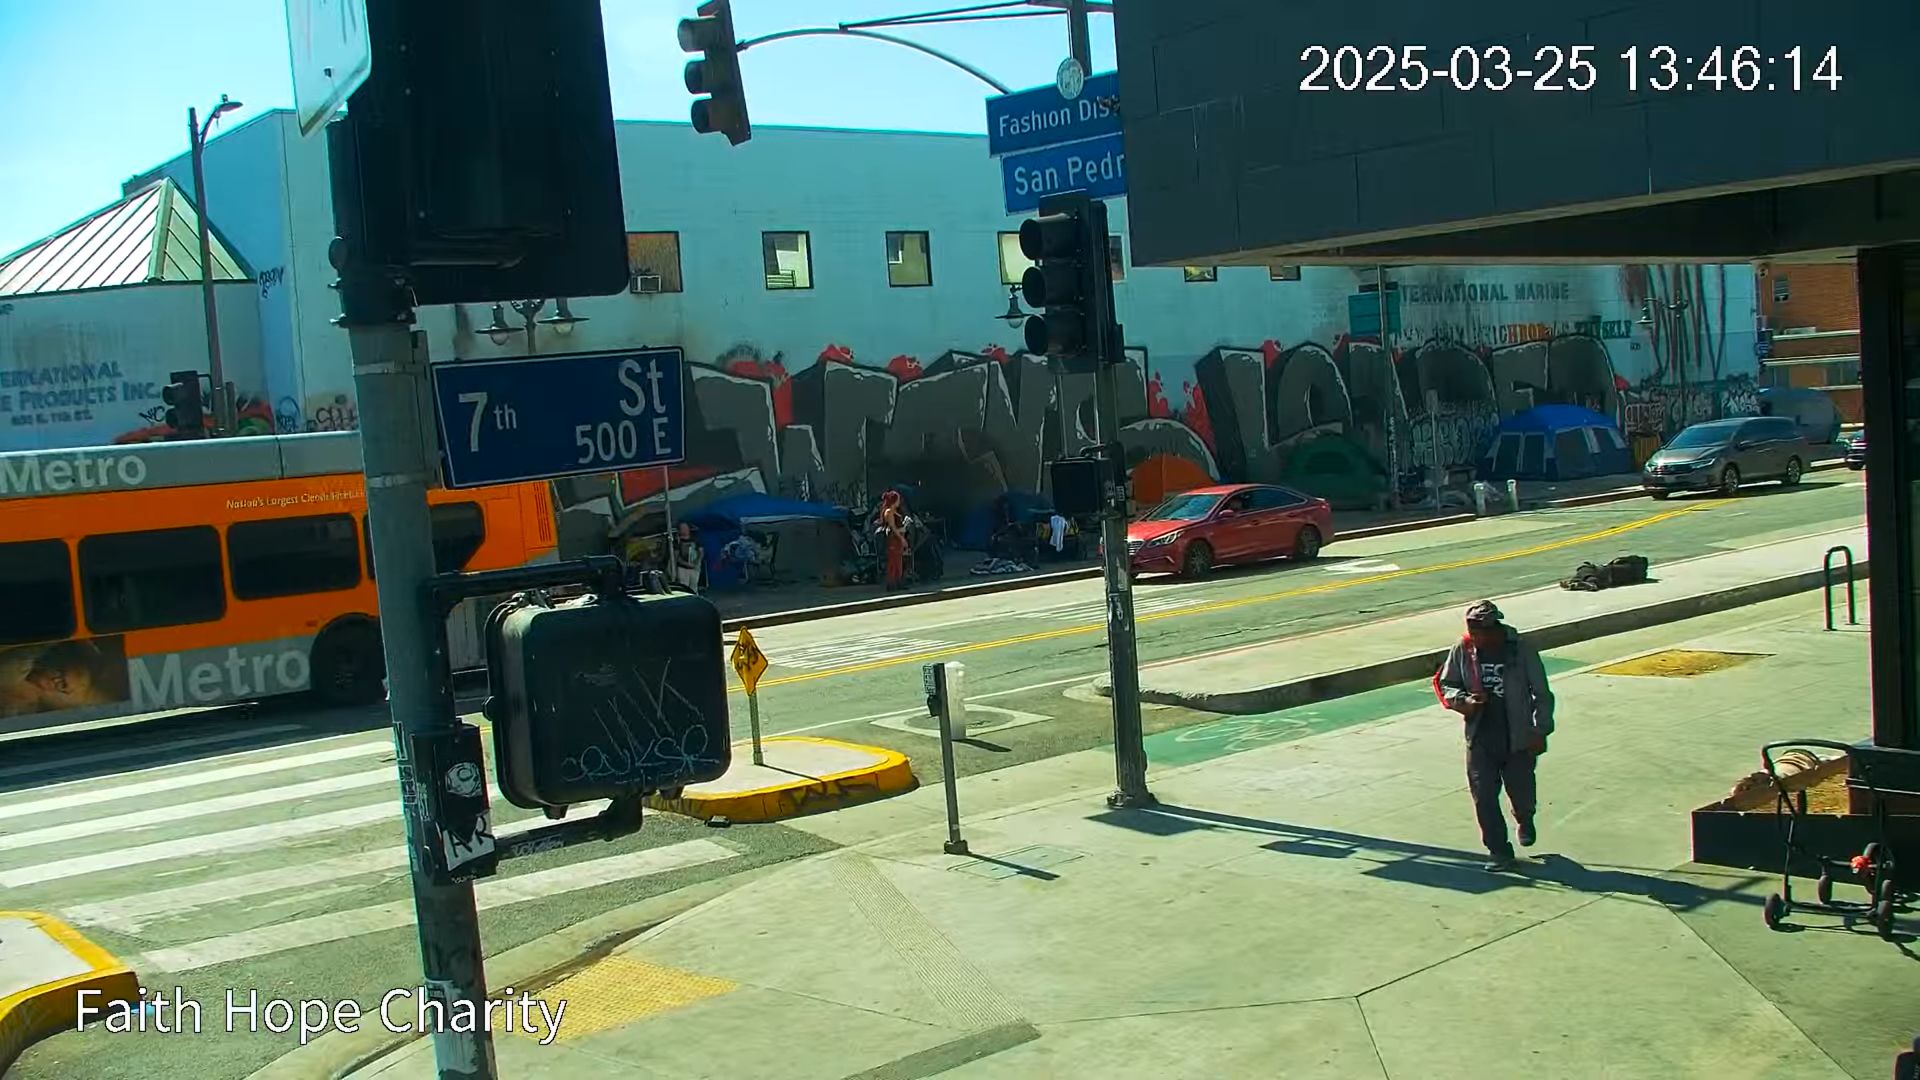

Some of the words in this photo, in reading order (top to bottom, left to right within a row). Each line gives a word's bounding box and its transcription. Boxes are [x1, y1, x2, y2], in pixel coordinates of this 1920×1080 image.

[999, 107, 1071, 137] Fashion
[1079, 95, 1119, 121] Dis
[1014, 166, 1059, 195] San
[458, 391, 517, 452] 7th
[618, 358, 667, 417] St
[575, 419, 638, 464] 500
[652, 416, 672, 455] E
[0, 452, 147, 494] Metro
[128, 648, 311, 709] Metro
